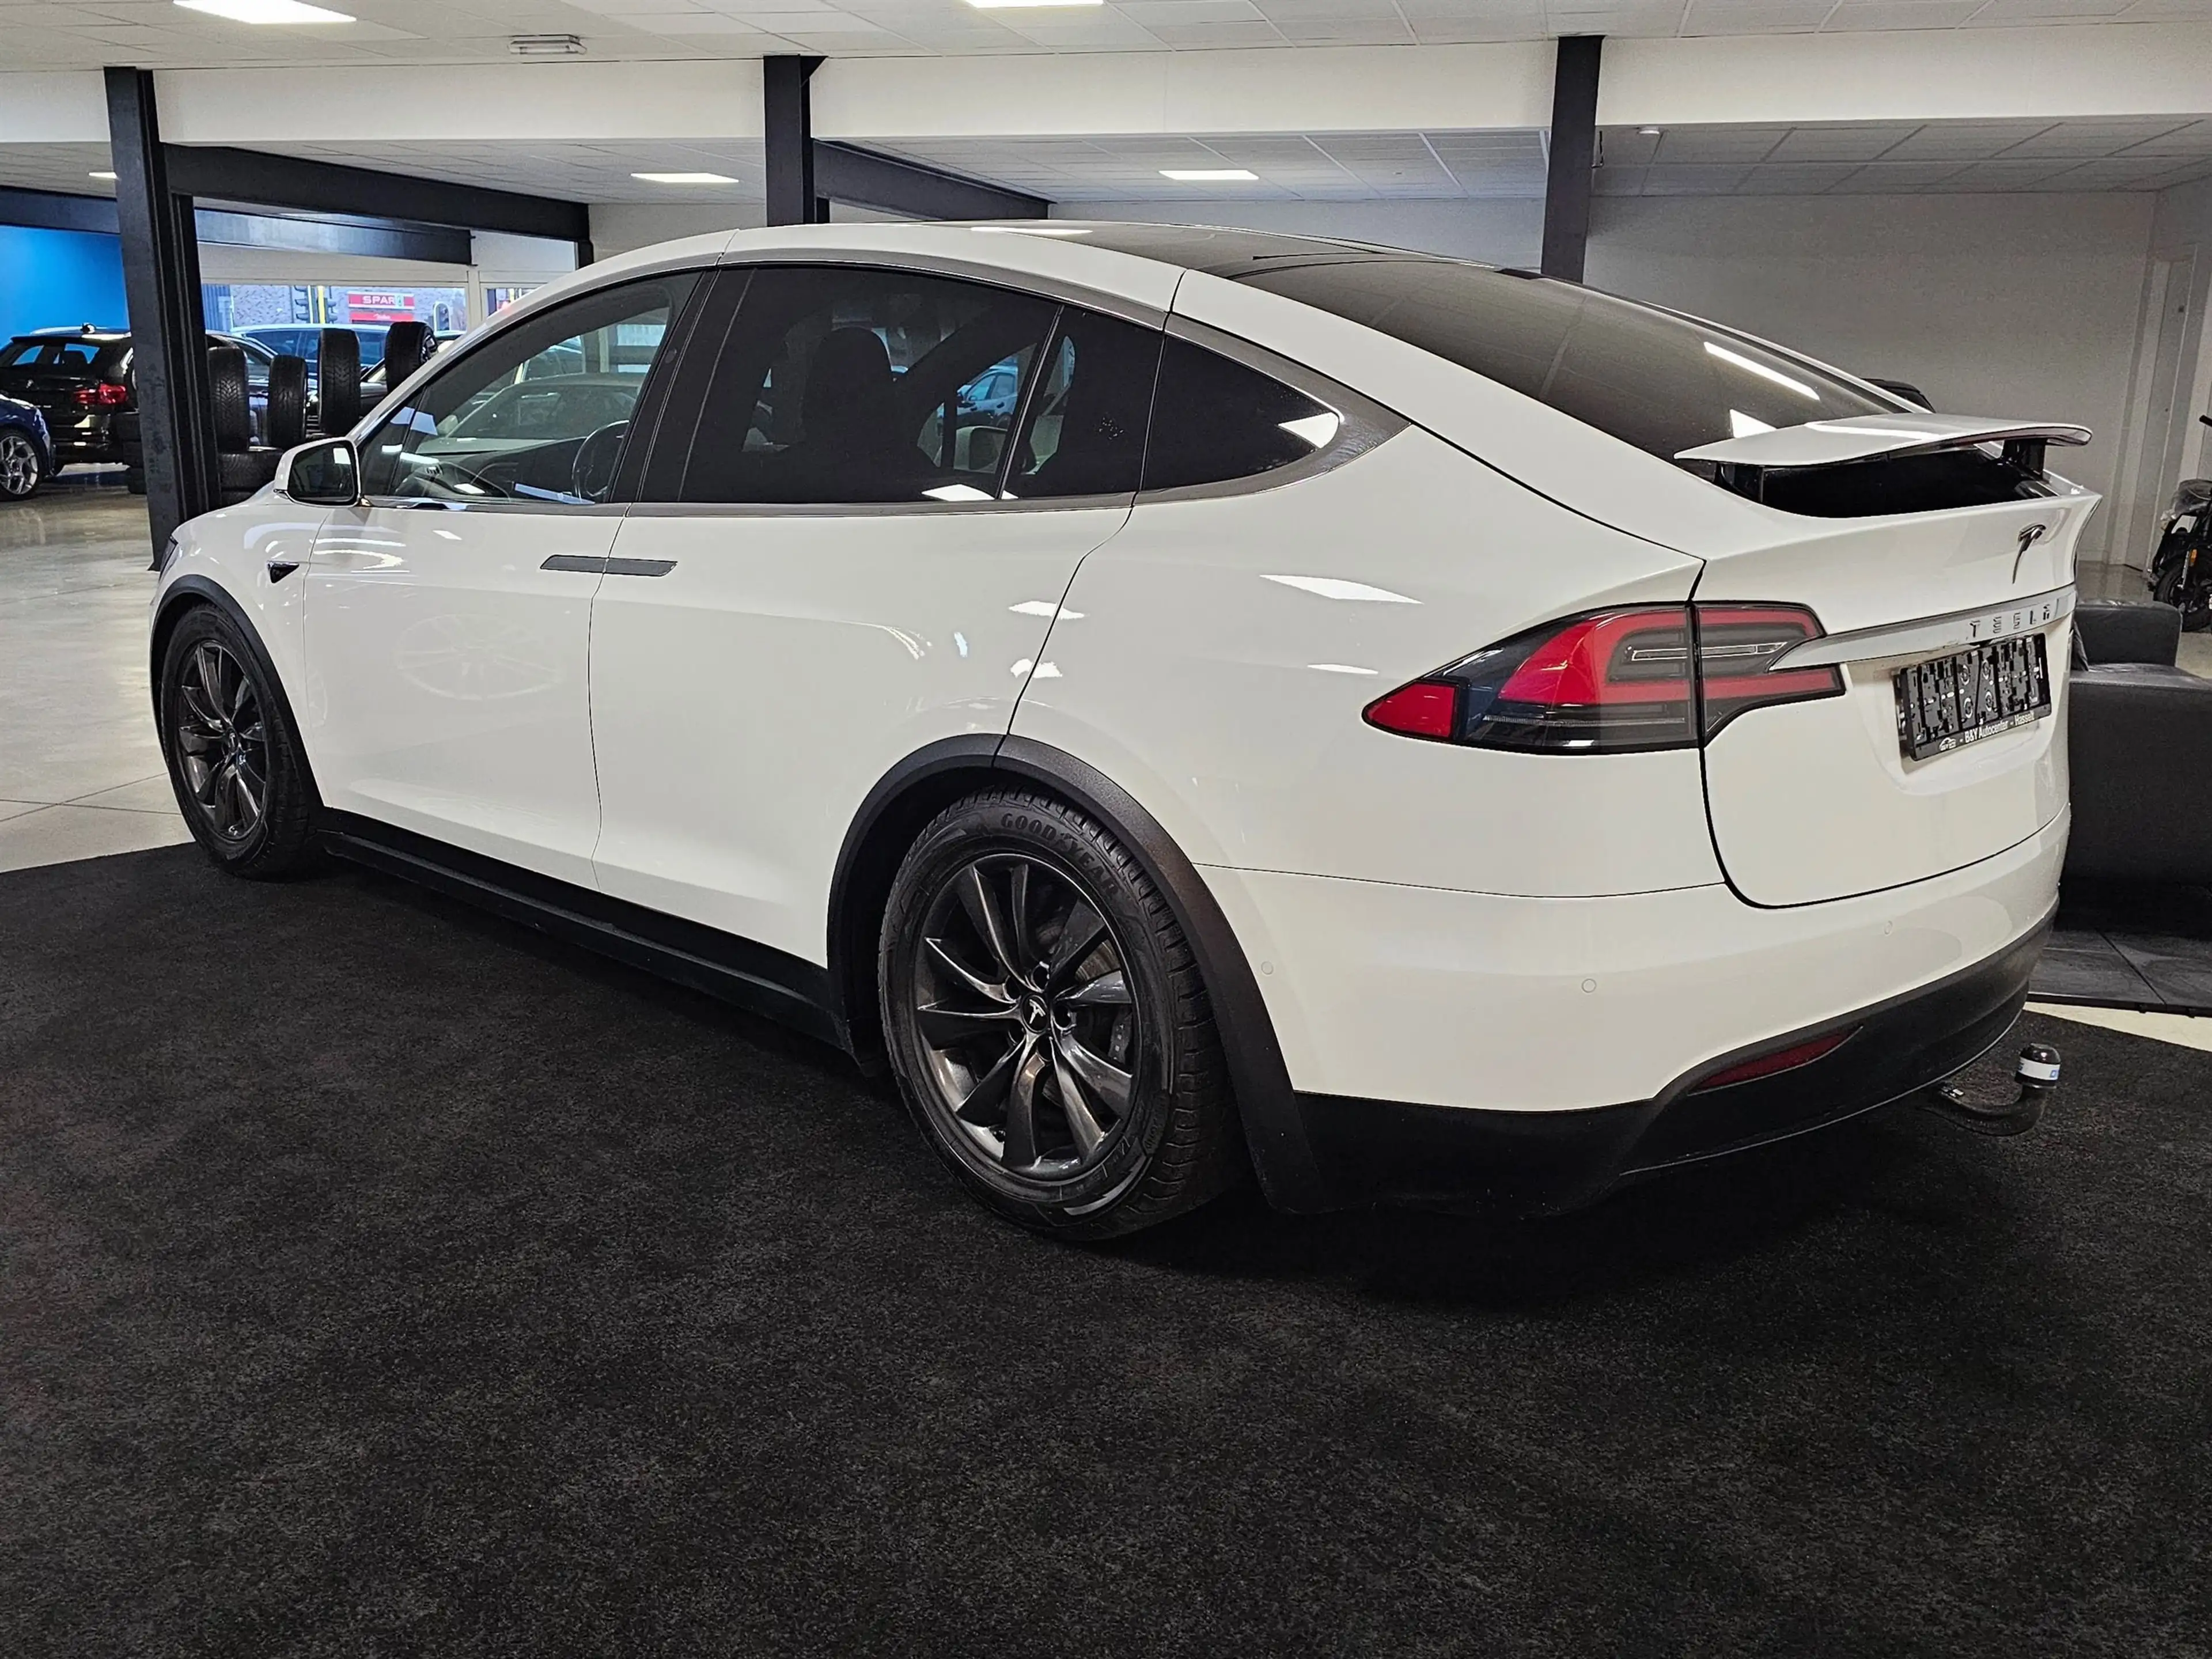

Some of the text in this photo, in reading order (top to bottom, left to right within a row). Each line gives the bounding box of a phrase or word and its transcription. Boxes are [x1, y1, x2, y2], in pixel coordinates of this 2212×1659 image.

[363, 295, 396, 305] SPAR
[1969, 604, 2051, 638] TESLA
[1979, 719, 2009, 738] Autocenter
